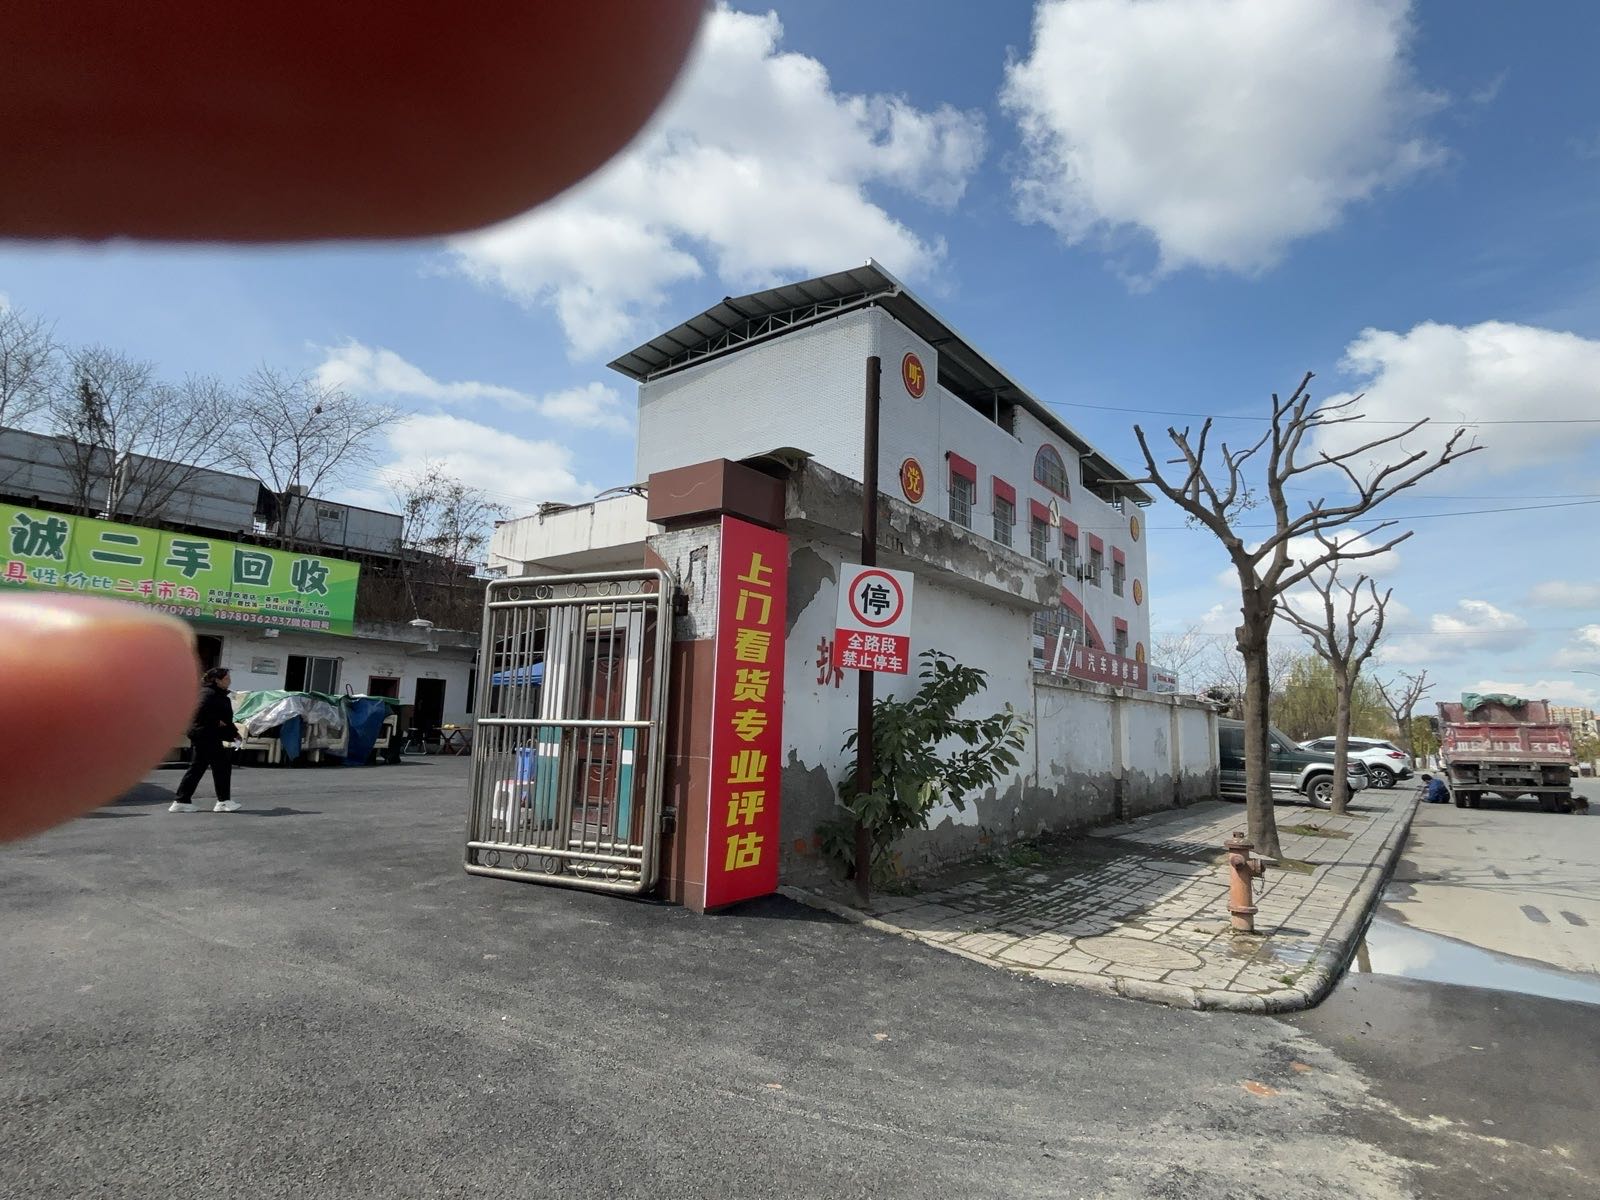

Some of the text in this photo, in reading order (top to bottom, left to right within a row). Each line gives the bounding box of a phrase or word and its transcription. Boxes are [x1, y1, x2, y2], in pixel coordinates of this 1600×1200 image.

[10, 512, 330, 596] 诚二手回收
[861, 582, 890, 616] 停
[847, 633, 896, 654] 全路段
[842, 650, 902, 672] 禁止停车
[724, 551, 774, 871] 上门看货专业评估
